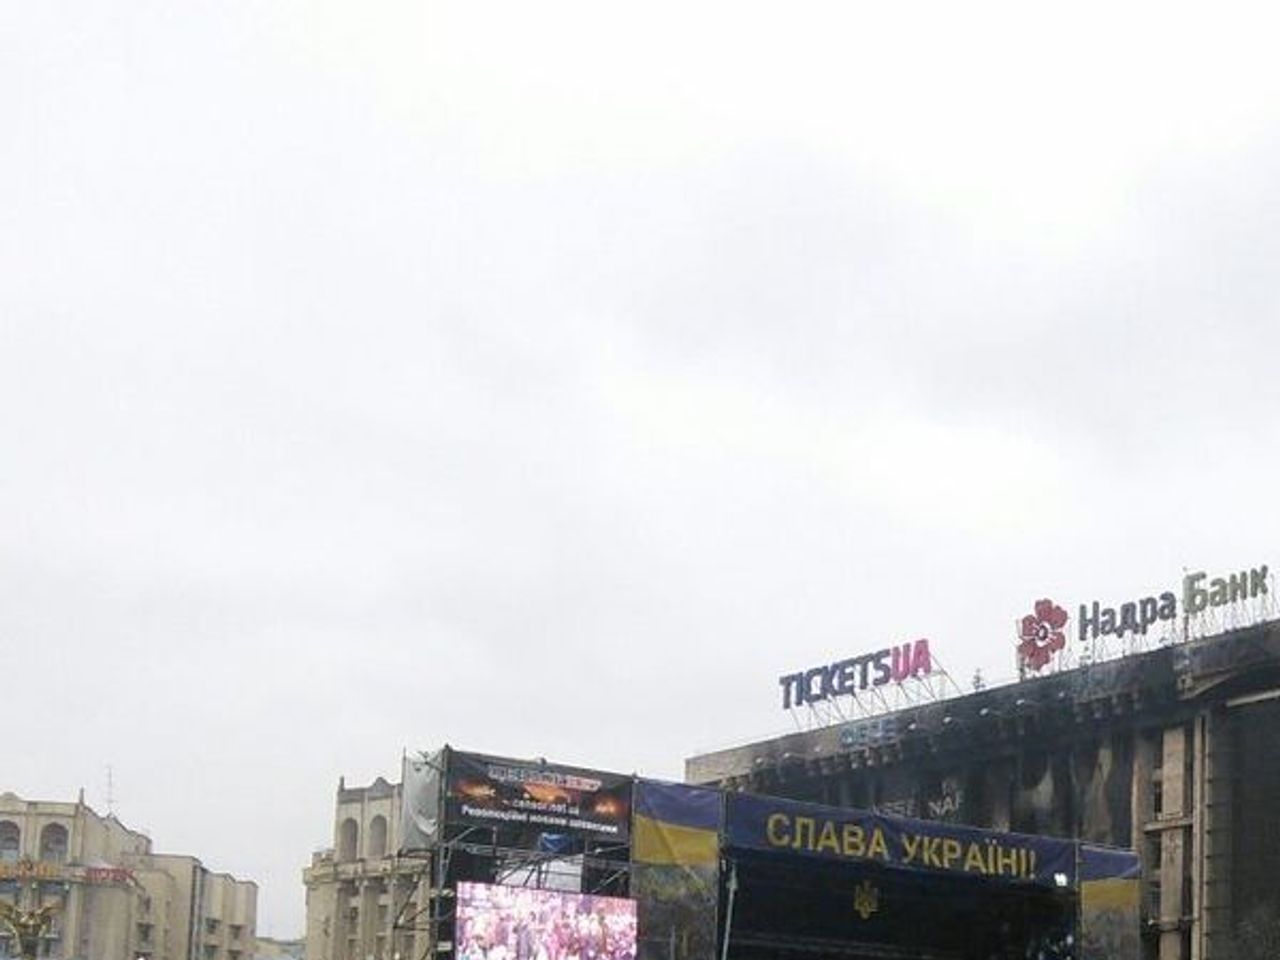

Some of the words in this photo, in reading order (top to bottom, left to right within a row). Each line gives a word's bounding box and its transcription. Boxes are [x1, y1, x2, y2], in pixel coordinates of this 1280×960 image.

[1079, 591, 1177, 641] Надра
[1182, 564, 1268, 615] Банк
[766, 812, 891, 861] СЛАВА
[902, 832, 1037, 879] УКРАЇНІ!
